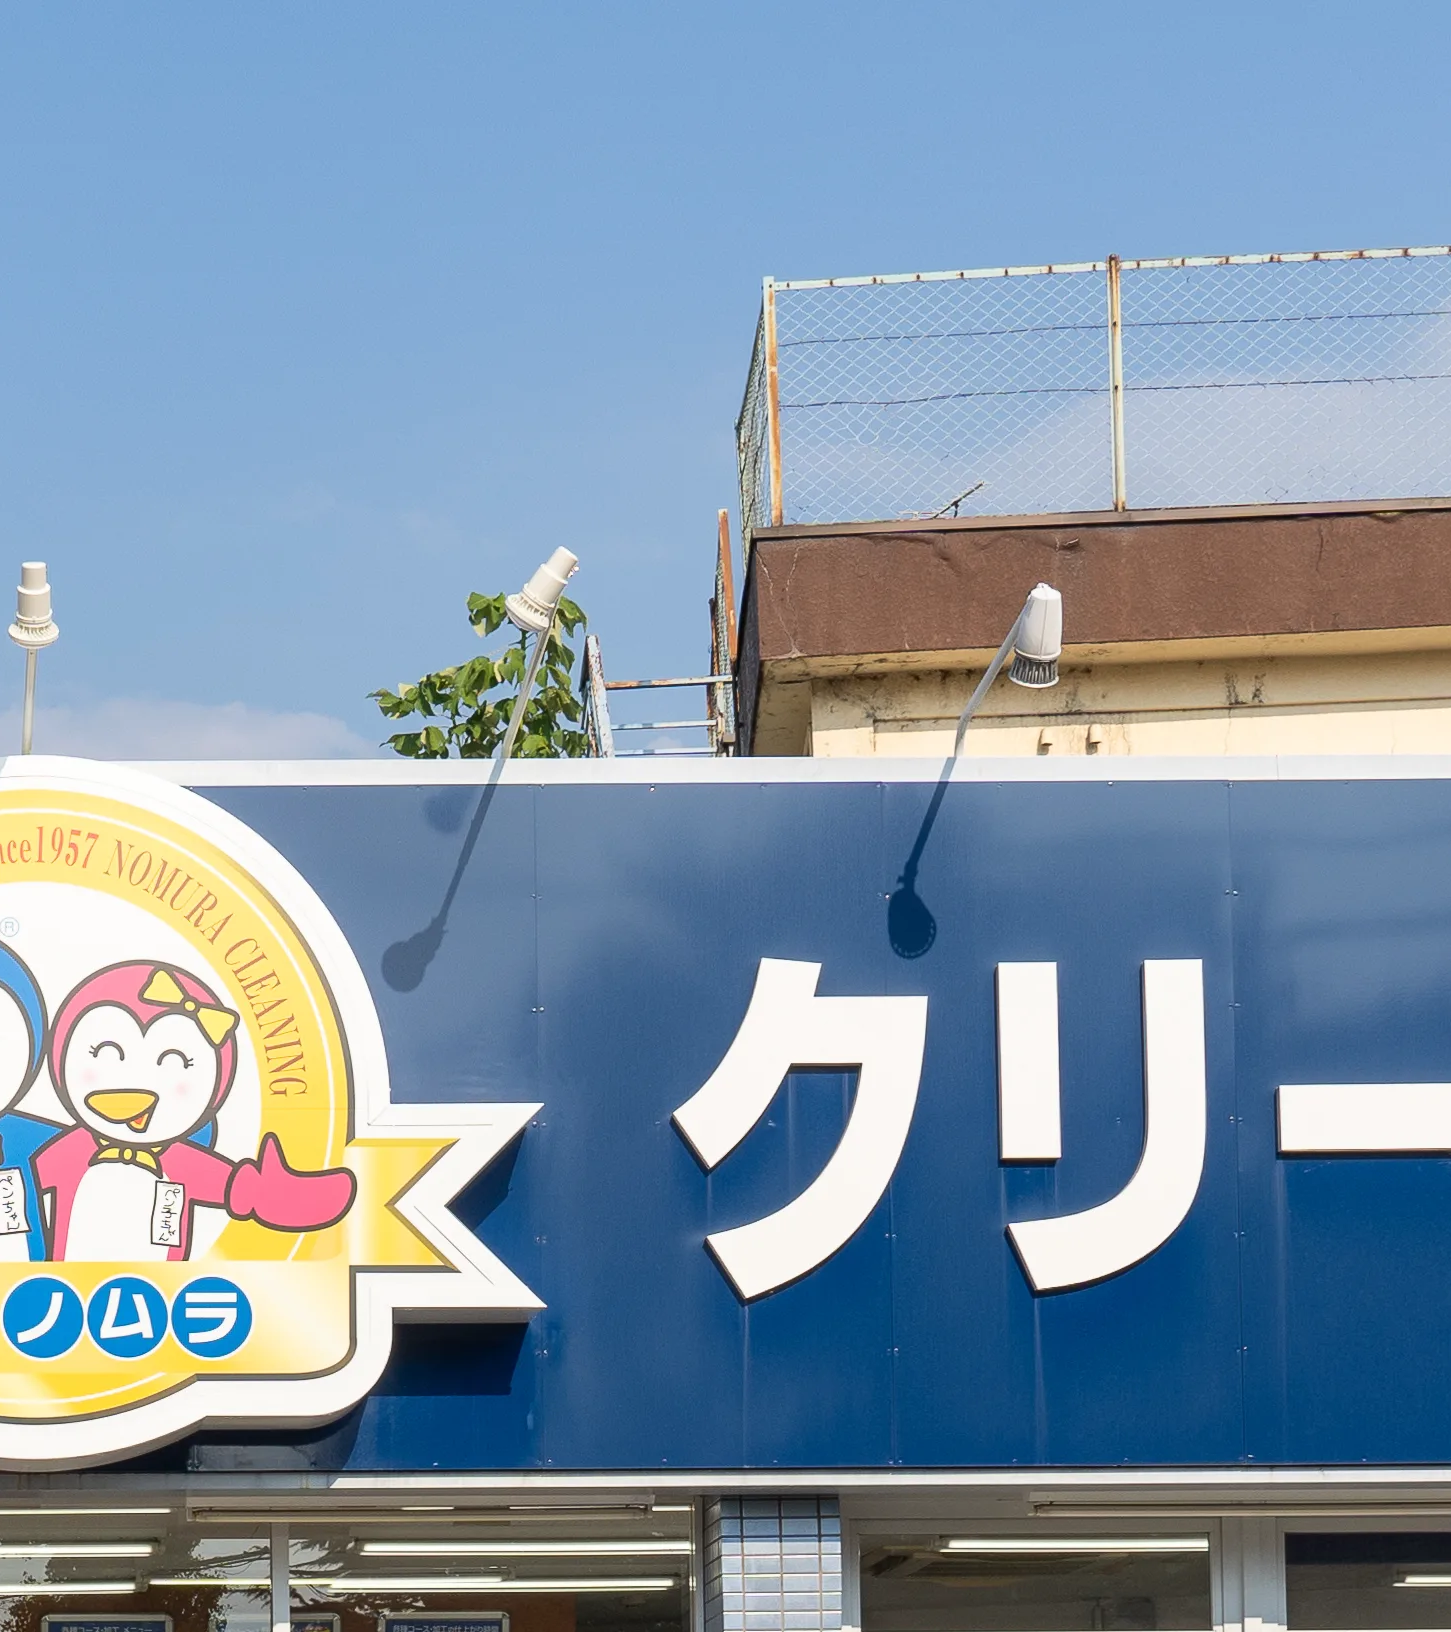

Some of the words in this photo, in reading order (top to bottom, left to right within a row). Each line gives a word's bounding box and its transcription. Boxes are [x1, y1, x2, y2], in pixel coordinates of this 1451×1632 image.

[102, 839, 232, 945] NOMURA
[223, 936, 308, 1098] CLEANING
[5, 1278, 249, 1355] ノムラ
